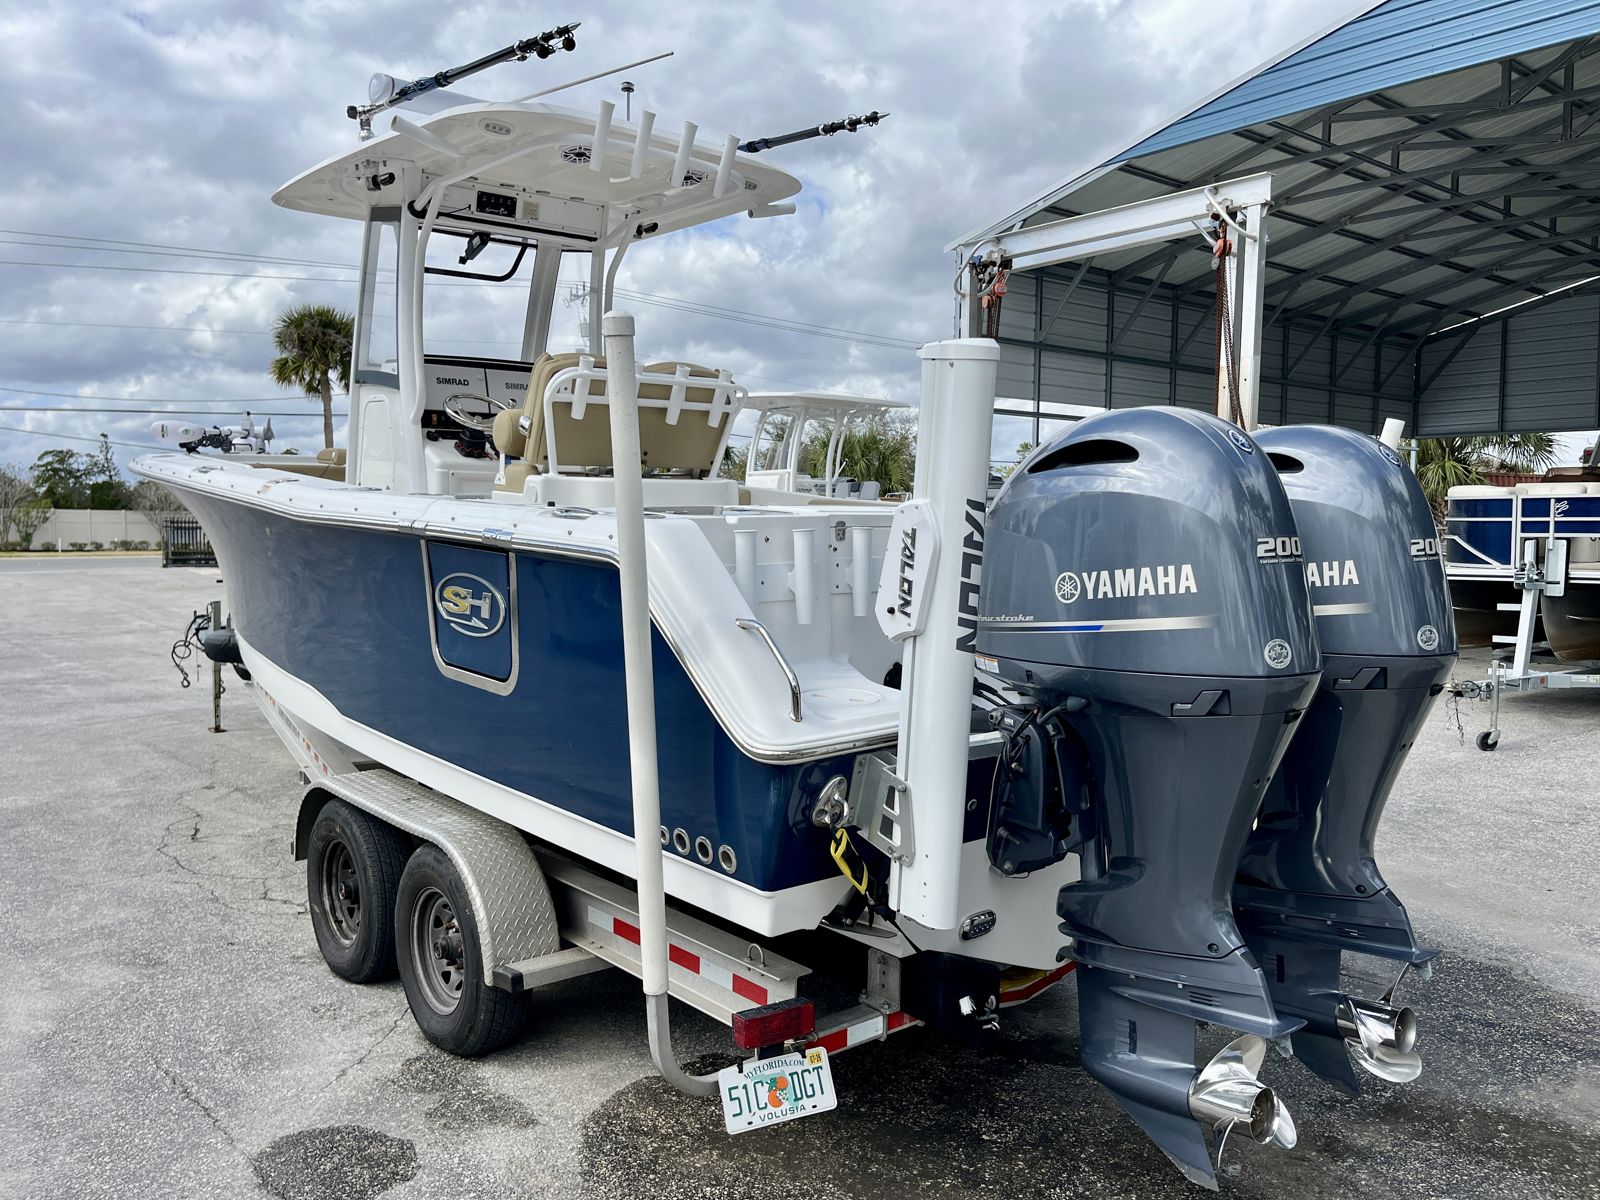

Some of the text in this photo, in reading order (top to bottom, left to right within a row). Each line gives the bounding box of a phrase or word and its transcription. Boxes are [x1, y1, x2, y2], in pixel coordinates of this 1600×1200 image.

[436, 376, 470, 387] SIMRAD
[505, 382, 528, 391] SIMRA
[1256, 537, 1302, 558] 200
[897, 527, 917, 619] TALON
[1081, 563, 1198, 600] YAMAHA
[1306, 559, 1360, 588] AHA
[743, 1059, 805, 1081] MYFLORIDA.COM
[727, 1066, 826, 1118] 51C DGT
[758, 1104, 807, 1122] VOLUSIA
